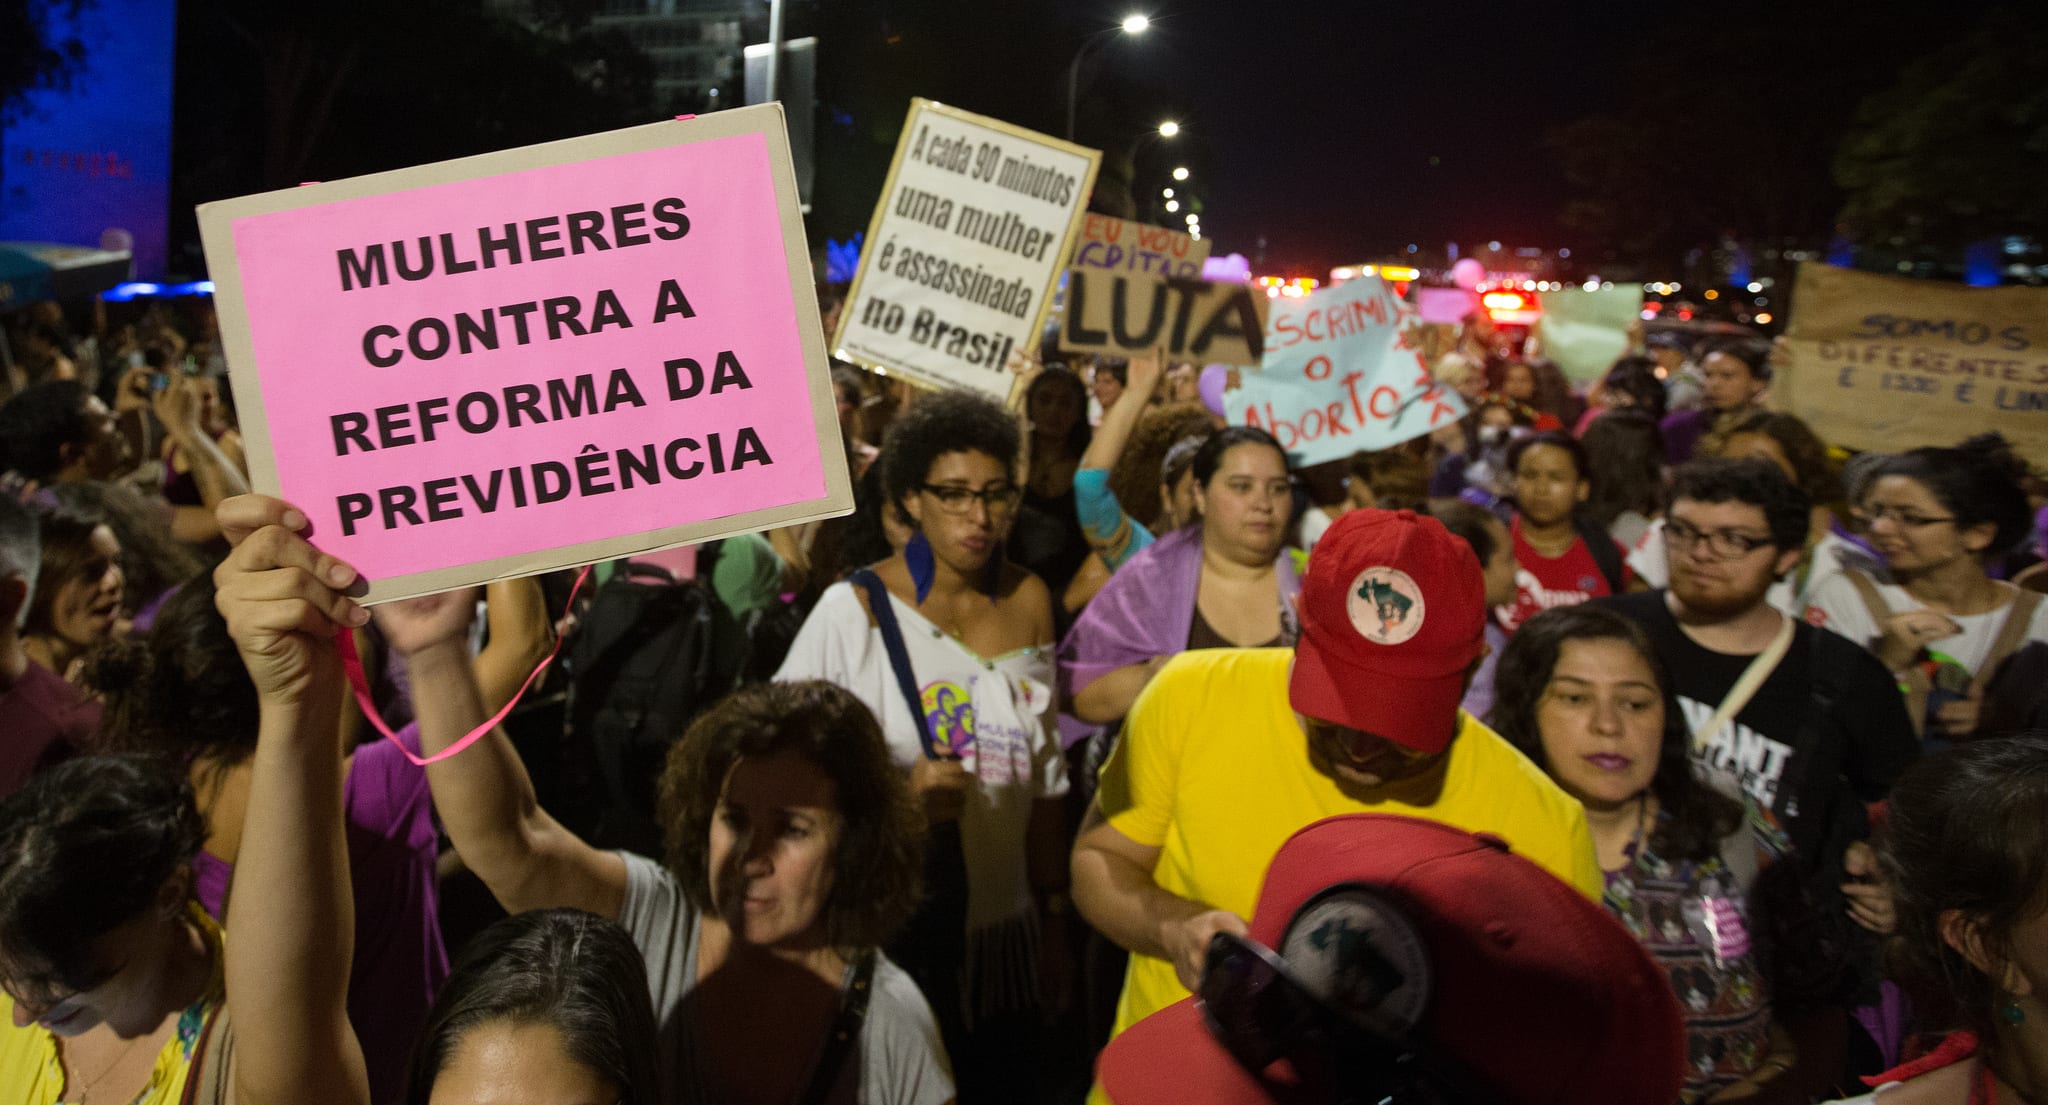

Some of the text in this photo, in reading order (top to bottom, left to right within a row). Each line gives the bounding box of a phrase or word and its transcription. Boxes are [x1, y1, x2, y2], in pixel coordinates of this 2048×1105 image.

[911, 125, 1076, 208] A cada 90 minutos
[336, 197, 691, 292] MULHERES
[895, 185, 1055, 263] uma mulher
[1084, 213, 1191, 258] EU VOU
[878, 233, 1034, 320] é assassinada
[1067, 271, 1265, 361] LUTA
[362, 278, 697, 368] CONTRA A
[861, 295, 905, 335] no
[909, 307, 1016, 374] Brasil
[1852, 314, 2031, 351] SOMOS
[330, 350, 753, 457] REFORMA DA
[1303, 355, 1333, 382] O
[335, 426, 774, 537] PREVIDÊNCIA
